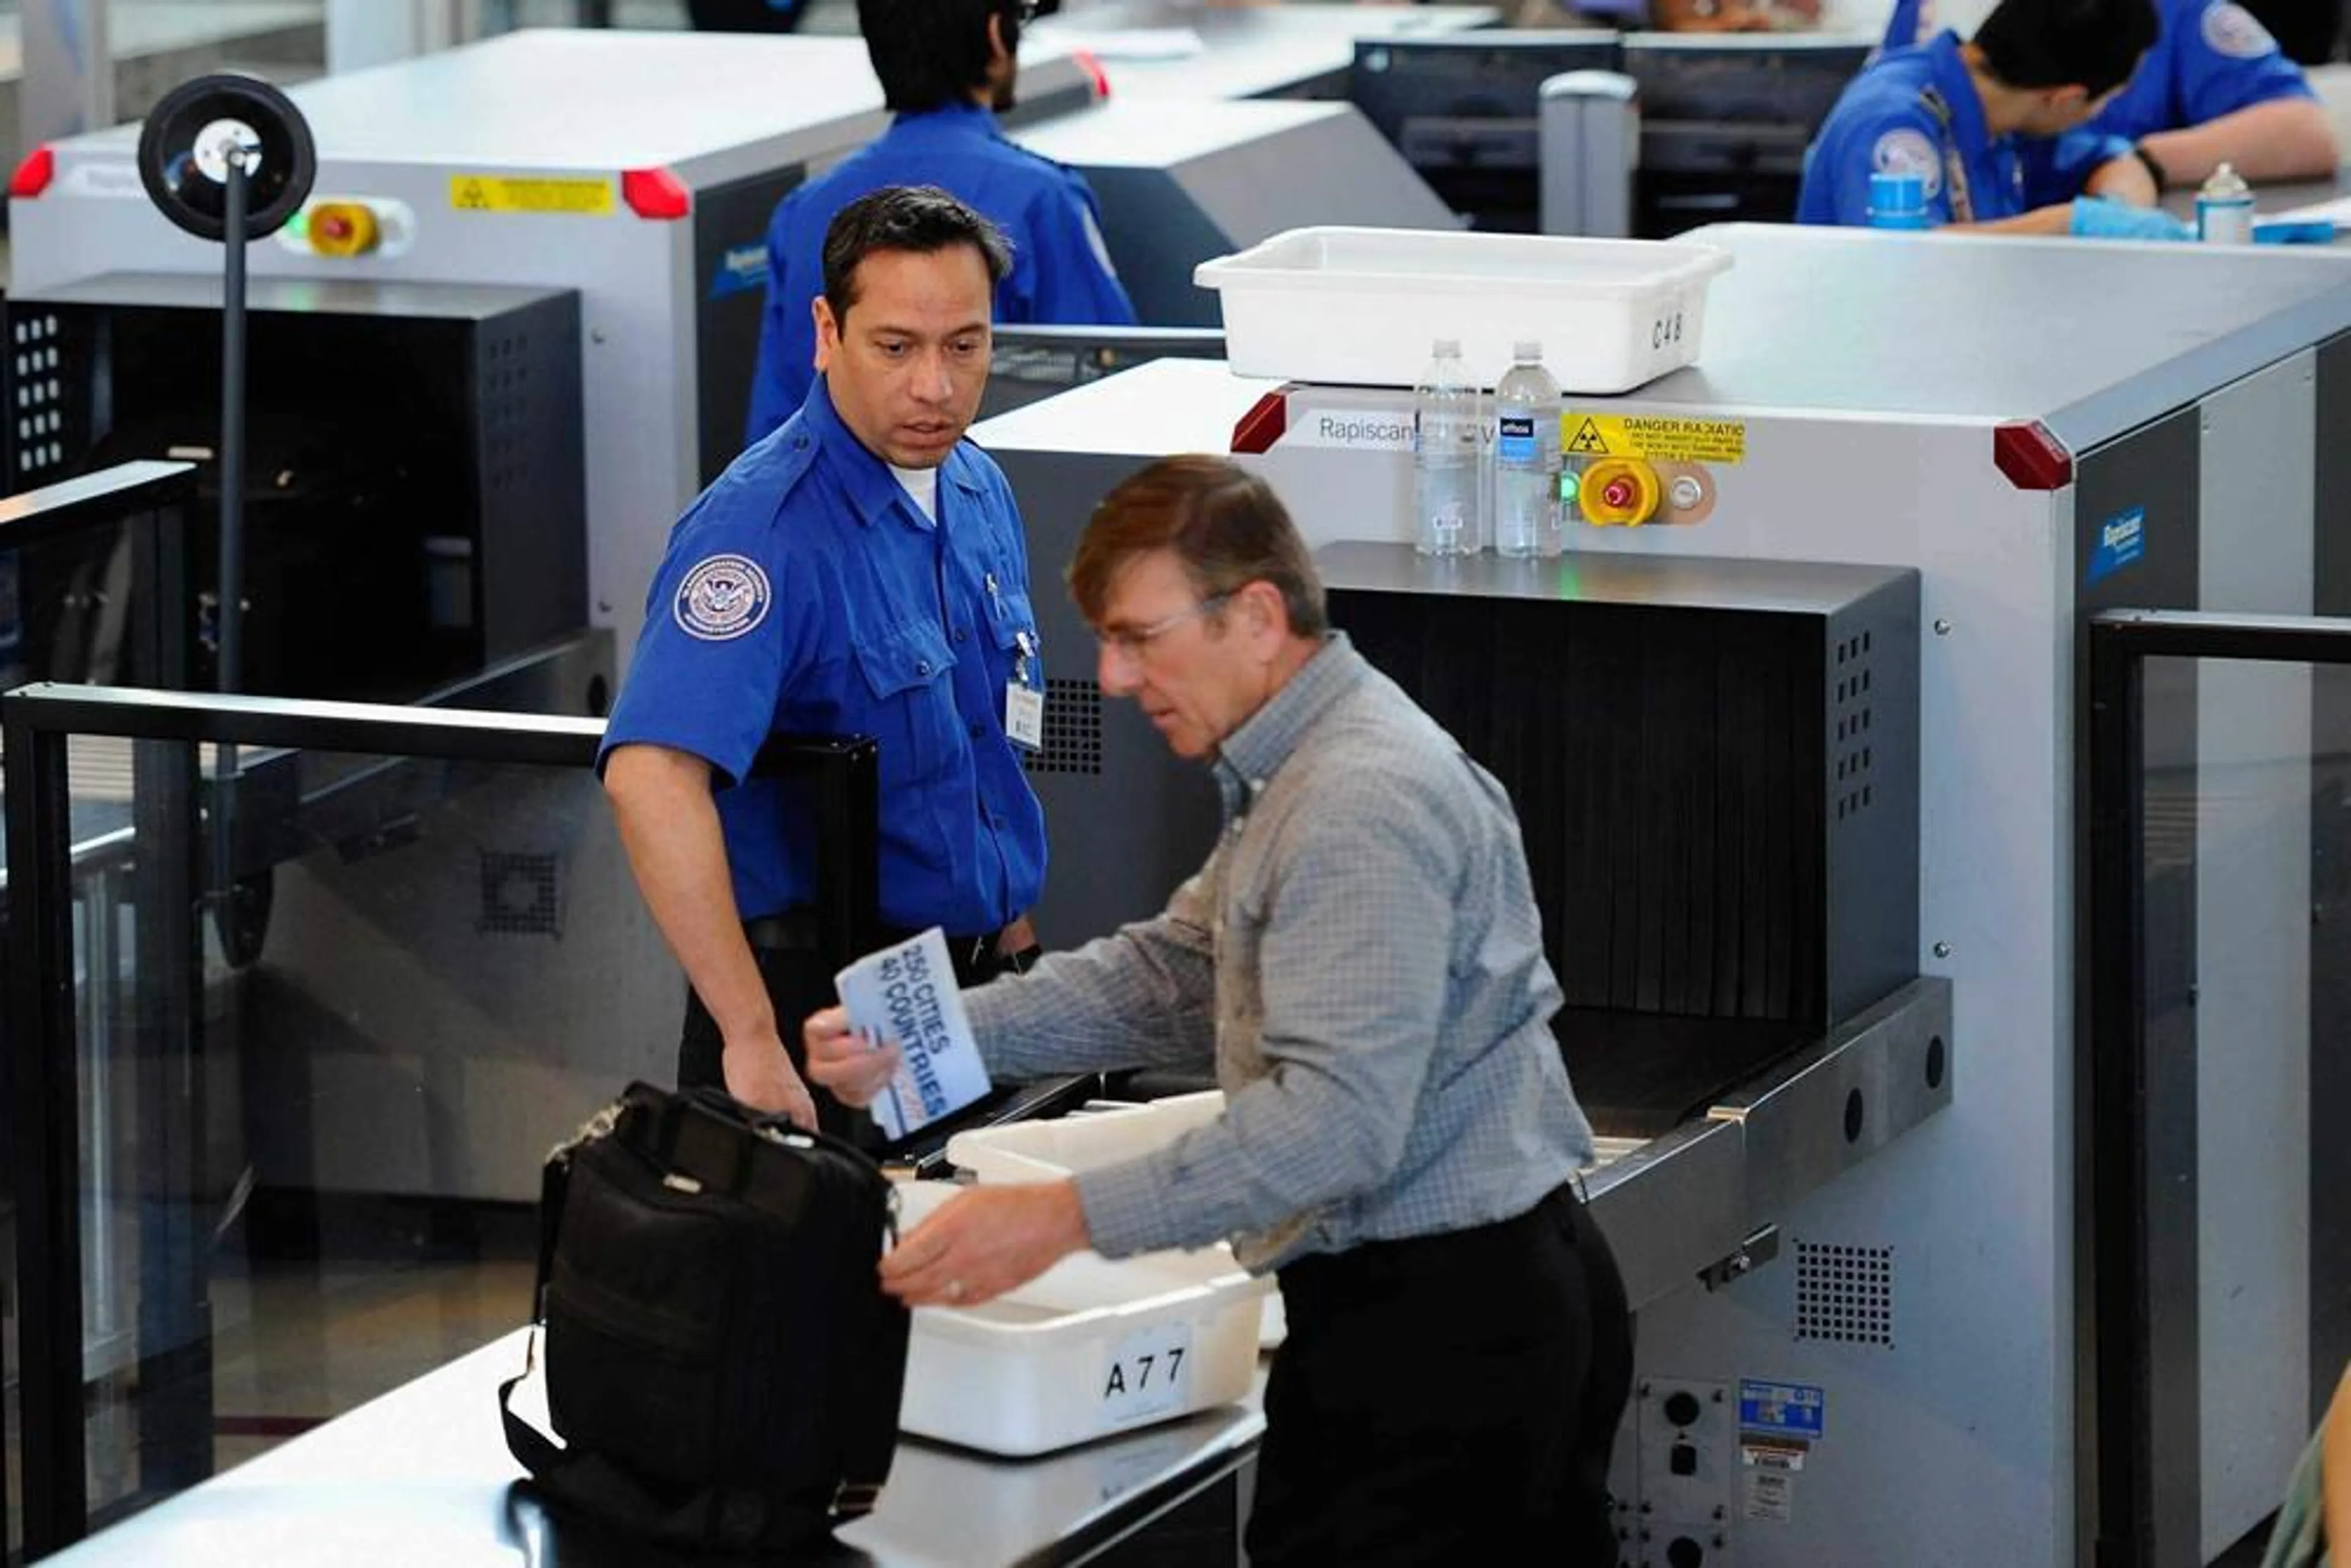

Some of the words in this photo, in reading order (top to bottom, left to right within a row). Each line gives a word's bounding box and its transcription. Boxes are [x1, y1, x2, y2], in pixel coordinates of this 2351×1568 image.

[1320, 417, 1413, 442] Rapiscan
[1623, 418, 1679, 433] DANGER
[880, 957, 903, 981] 40
[912, 982, 951, 1055] CITIES
[885, 981, 948, 1117] COUNTRIES
